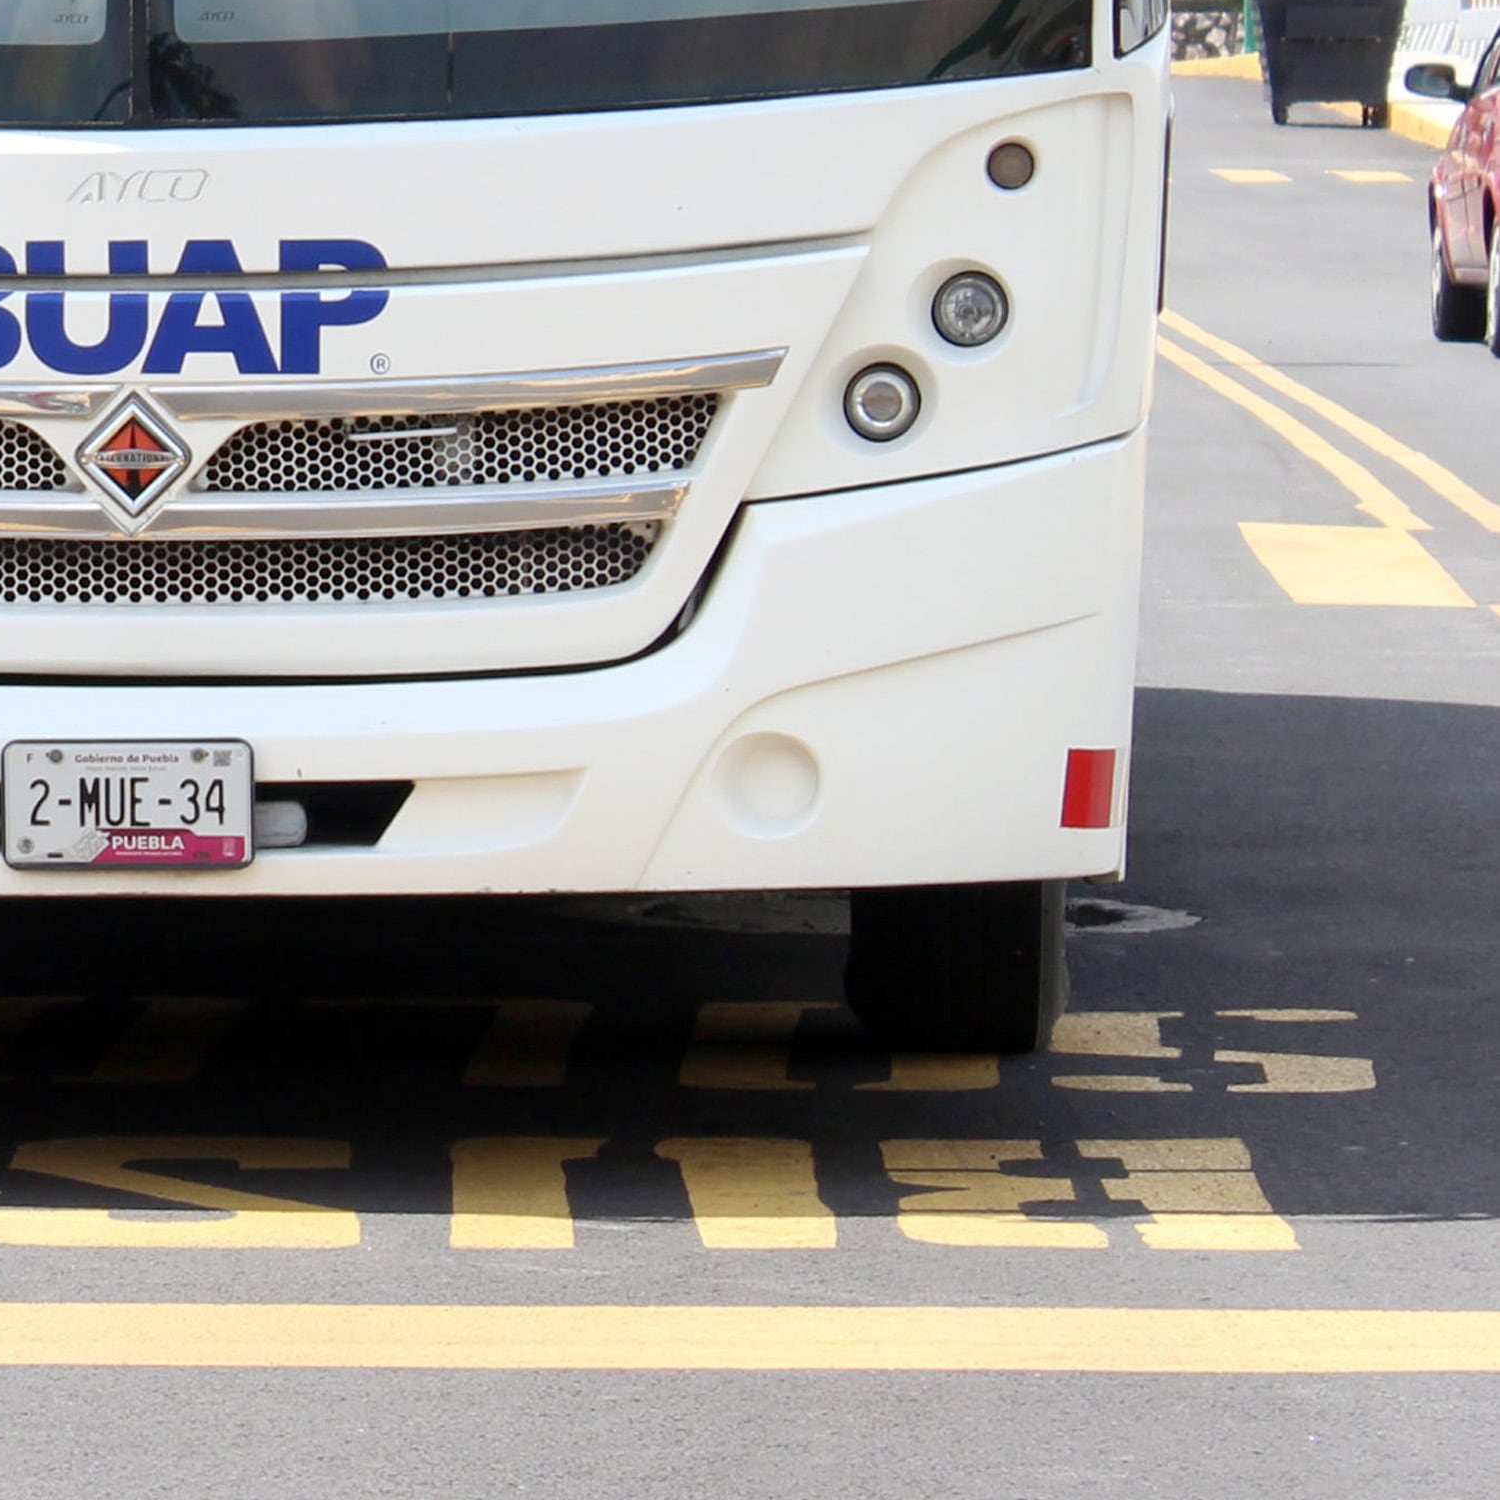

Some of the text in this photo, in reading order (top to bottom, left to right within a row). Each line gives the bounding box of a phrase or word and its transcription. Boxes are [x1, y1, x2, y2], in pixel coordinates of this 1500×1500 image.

[26, 753, 179, 764] F Gobierno de Puebla
[29, 776, 226, 828] 2-MUE-34
[111, 835, 185, 850] PUEBLA
